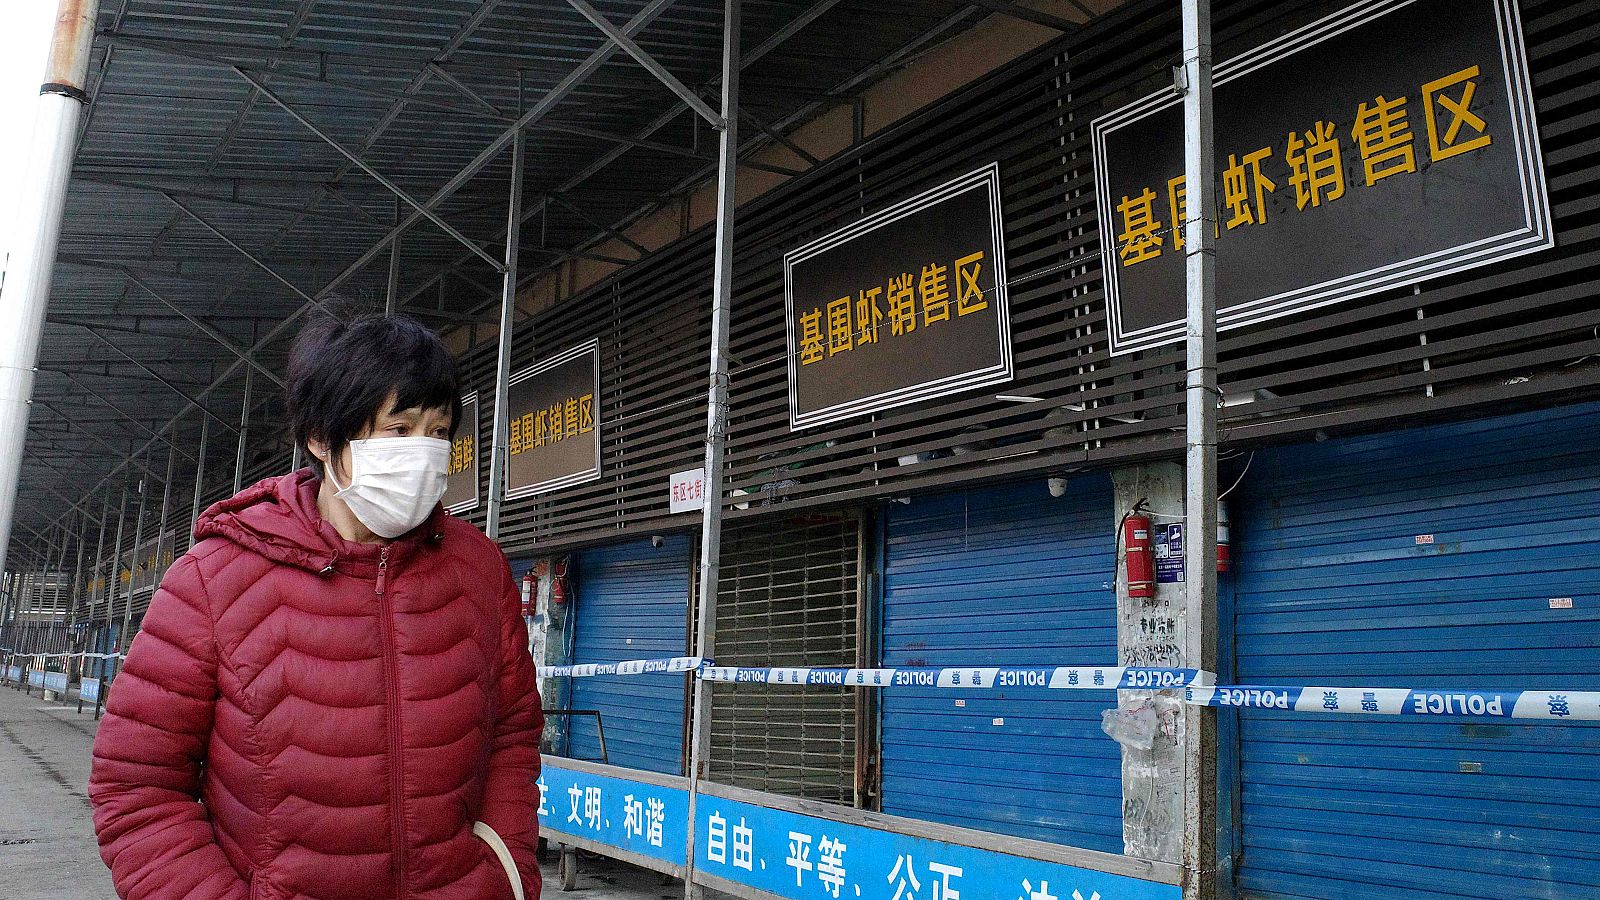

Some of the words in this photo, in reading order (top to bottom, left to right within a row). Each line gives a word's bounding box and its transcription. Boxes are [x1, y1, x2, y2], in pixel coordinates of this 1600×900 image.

[799, 251, 989, 366] 基围虾销售区
[510, 393, 594, 456] 基围虾销售区
[672, 479, 702, 503] 东区七街
[596, 664, 616, 675] POLICE
[645, 660, 667, 672] POLICE
[738, 669, 766, 682] POLICE
[810, 671, 842, 684] POLICE
[896, 671, 934, 685] POLICE
[951, 670, 981, 686] 警察
[1000, 670, 1045, 686] POLICE
[1068, 669, 1105, 686] 警察
[1128, 670, 1185, 687] POLICE
[1219, 688, 1288, 709] POLICE
[1323, 690, 1379, 712] 警察
[1414, 693, 1503, 716] POLICE
